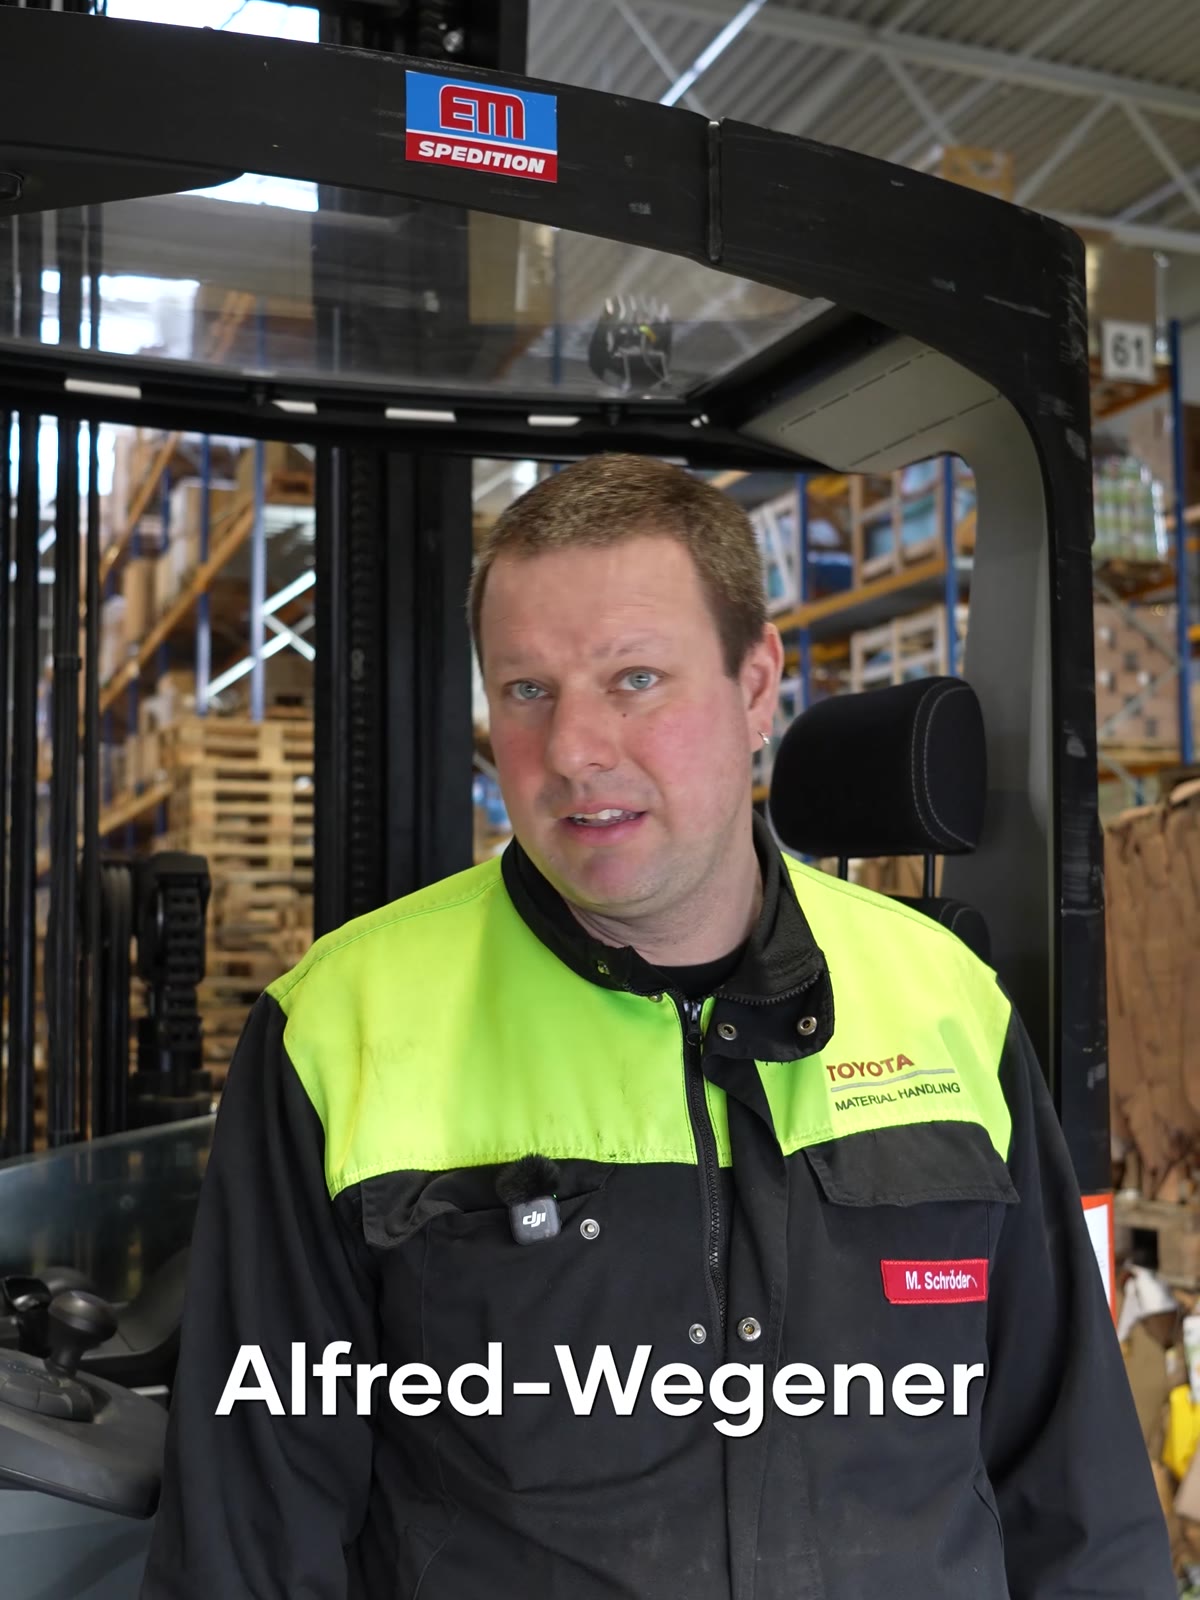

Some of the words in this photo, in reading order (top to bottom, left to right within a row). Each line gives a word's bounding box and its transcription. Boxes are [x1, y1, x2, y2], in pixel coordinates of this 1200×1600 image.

[418, 141, 546, 174] SPEDITION
[1111, 333, 1145, 368] 61
[826, 1053, 914, 1082] TOYOTA
[834, 1091, 897, 1112] MATERIAL
[899, 1082, 961, 1100] HANDLING
[905, 1270, 921, 1290] M.
[924, 1269, 972, 1290] Schröder
